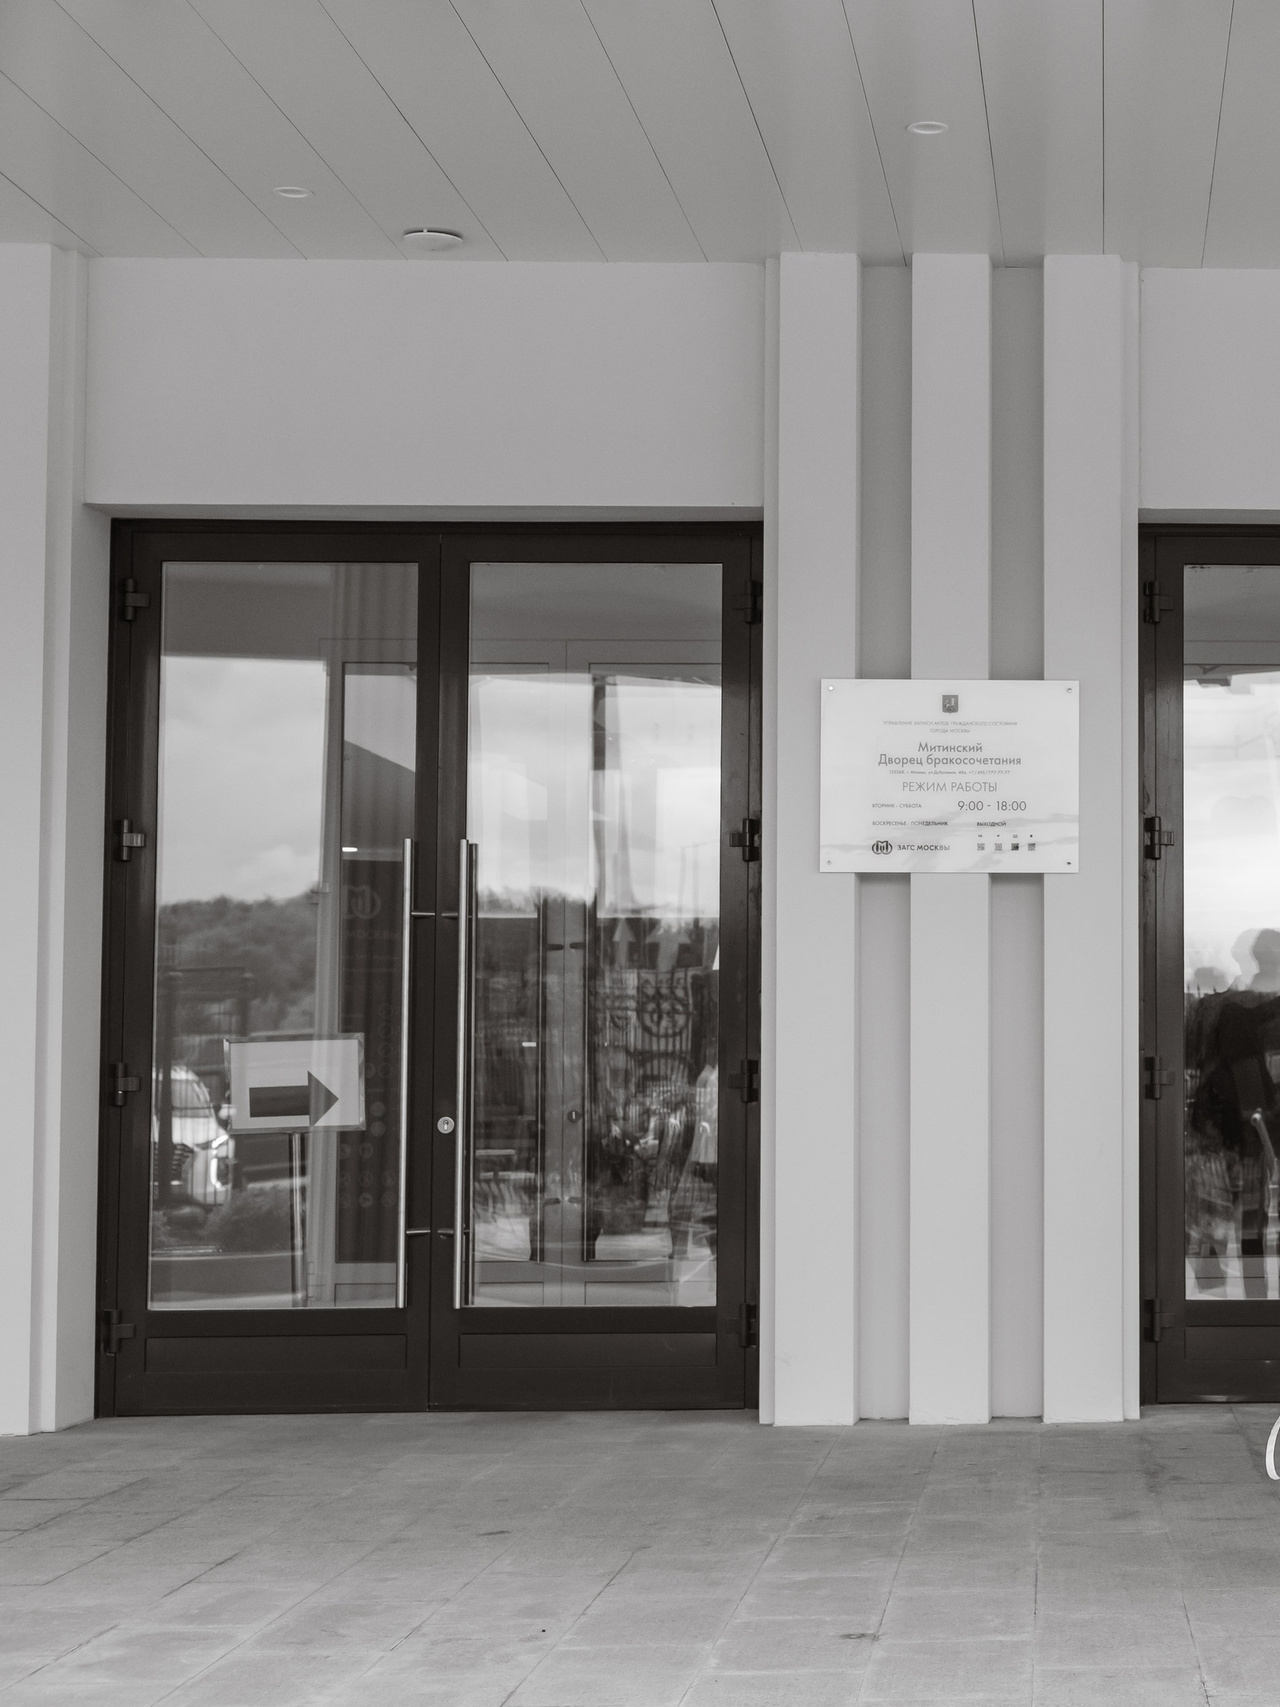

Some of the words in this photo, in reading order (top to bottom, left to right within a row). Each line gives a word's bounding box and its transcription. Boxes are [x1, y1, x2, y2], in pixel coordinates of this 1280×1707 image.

[918, 741, 983, 753] Митинский
[878, 754, 923, 767] Дворец
[926, 753, 1022, 768] бракосочетания
[902, 781, 947, 793] РЕЖИМ
[951, 781, 998, 793] РАБОТЫ
[957, 800, 984, 812] 9:00
[996, 800, 1027, 812] 18:00
